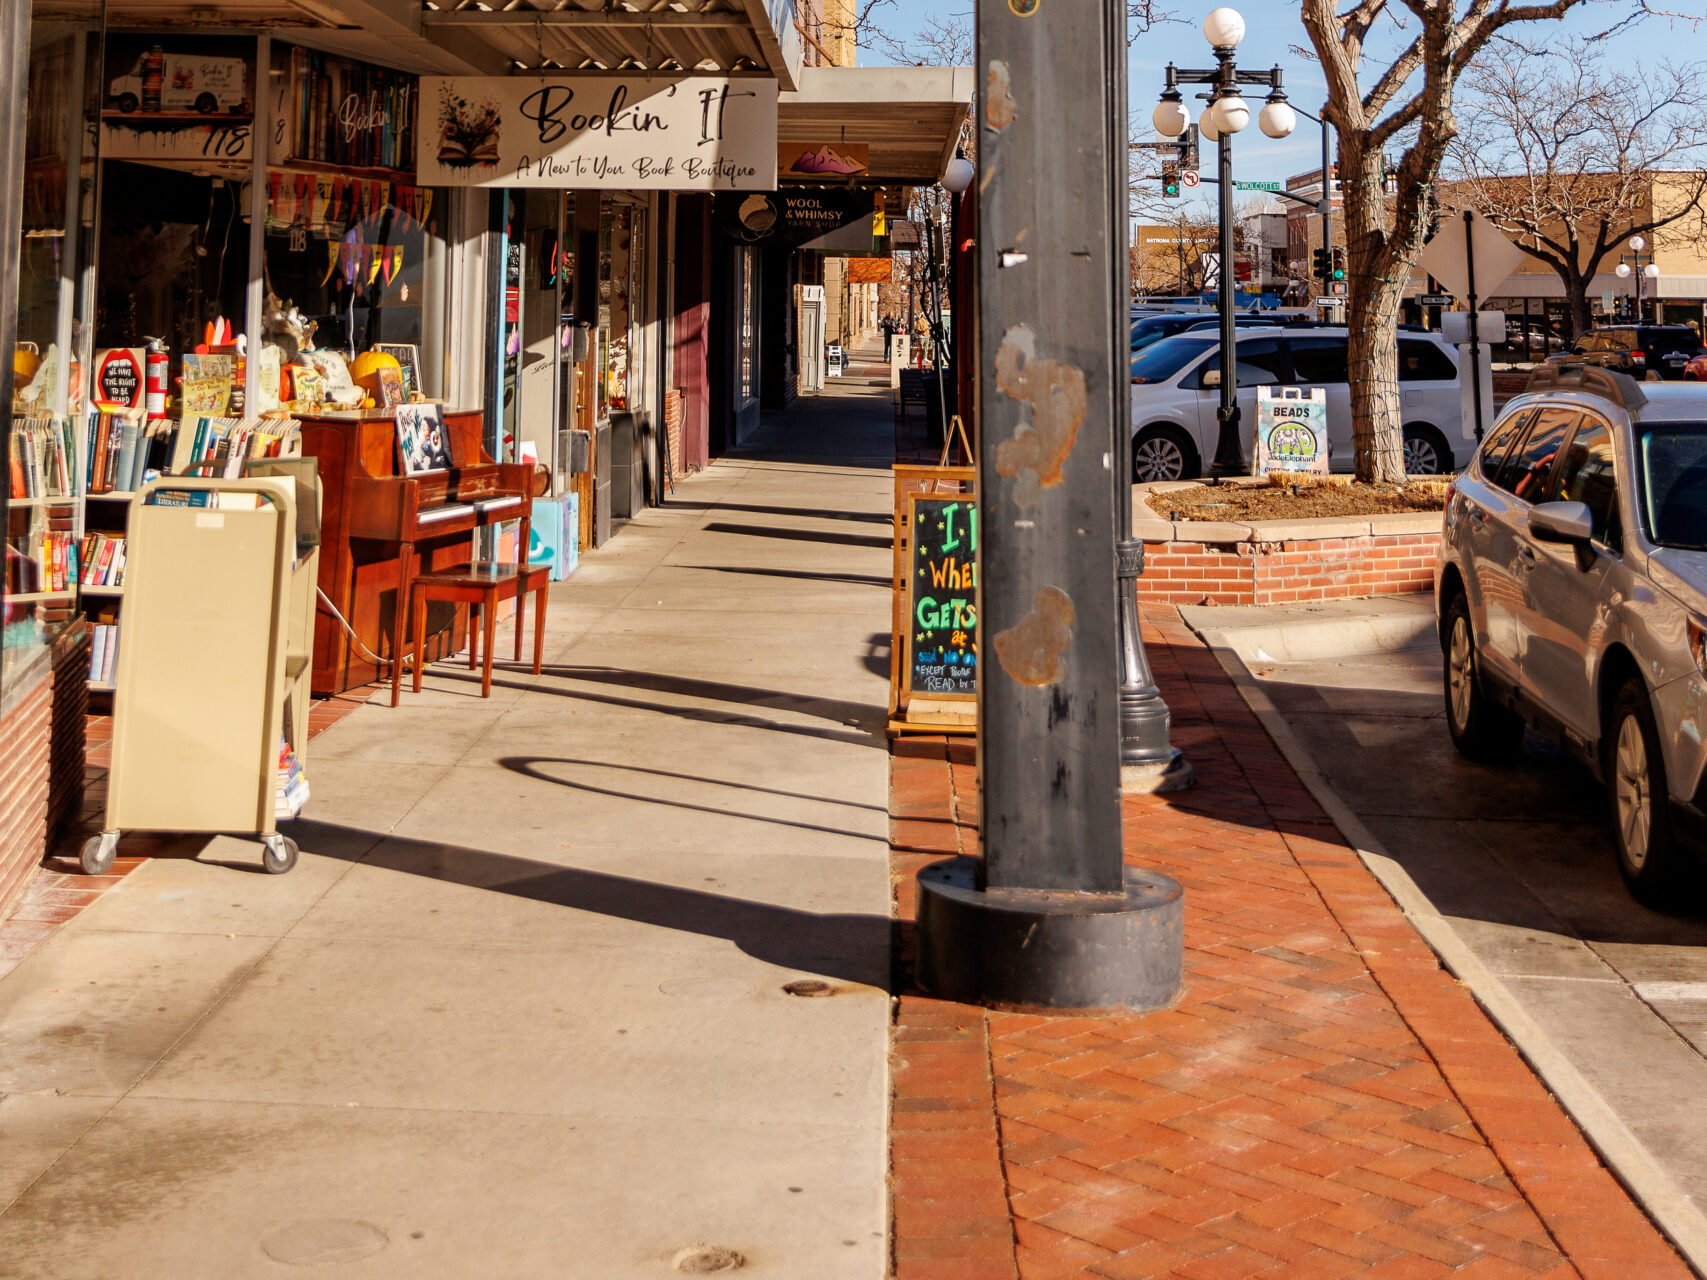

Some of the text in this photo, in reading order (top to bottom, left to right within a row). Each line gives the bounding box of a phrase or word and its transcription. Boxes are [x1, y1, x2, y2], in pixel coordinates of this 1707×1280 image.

[339, 86, 394, 144] Bookin'
[519, 83, 756, 147] Bookin' It
[203, 125, 250, 157] 118
[516, 155, 531, 179] A
[538, 155, 570, 179] New
[573, 156, 591, 176] to
[592, 155, 625, 179] You
[631, 156, 676, 179] Book
[681, 156, 757, 188] Boutique
[1241, 182, 1273, 191] WOLCOTT
[785, 198, 823, 209] WOOL
[785, 210, 843, 220] & WHIMSY
[289, 230, 307, 252] 118
[108, 367, 132, 376] WE HAVE
[104, 378, 136, 386] THE RIGHT
[1273, 407, 1310, 417] BEADS
[941, 502, 960, 554] I
[916, 596, 977, 630] GETS
[951, 630, 968, 647] at
[918, 647, 977, 667] said NO ON
[924, 676, 956, 692] READ
[959, 680, 968, 689] by
